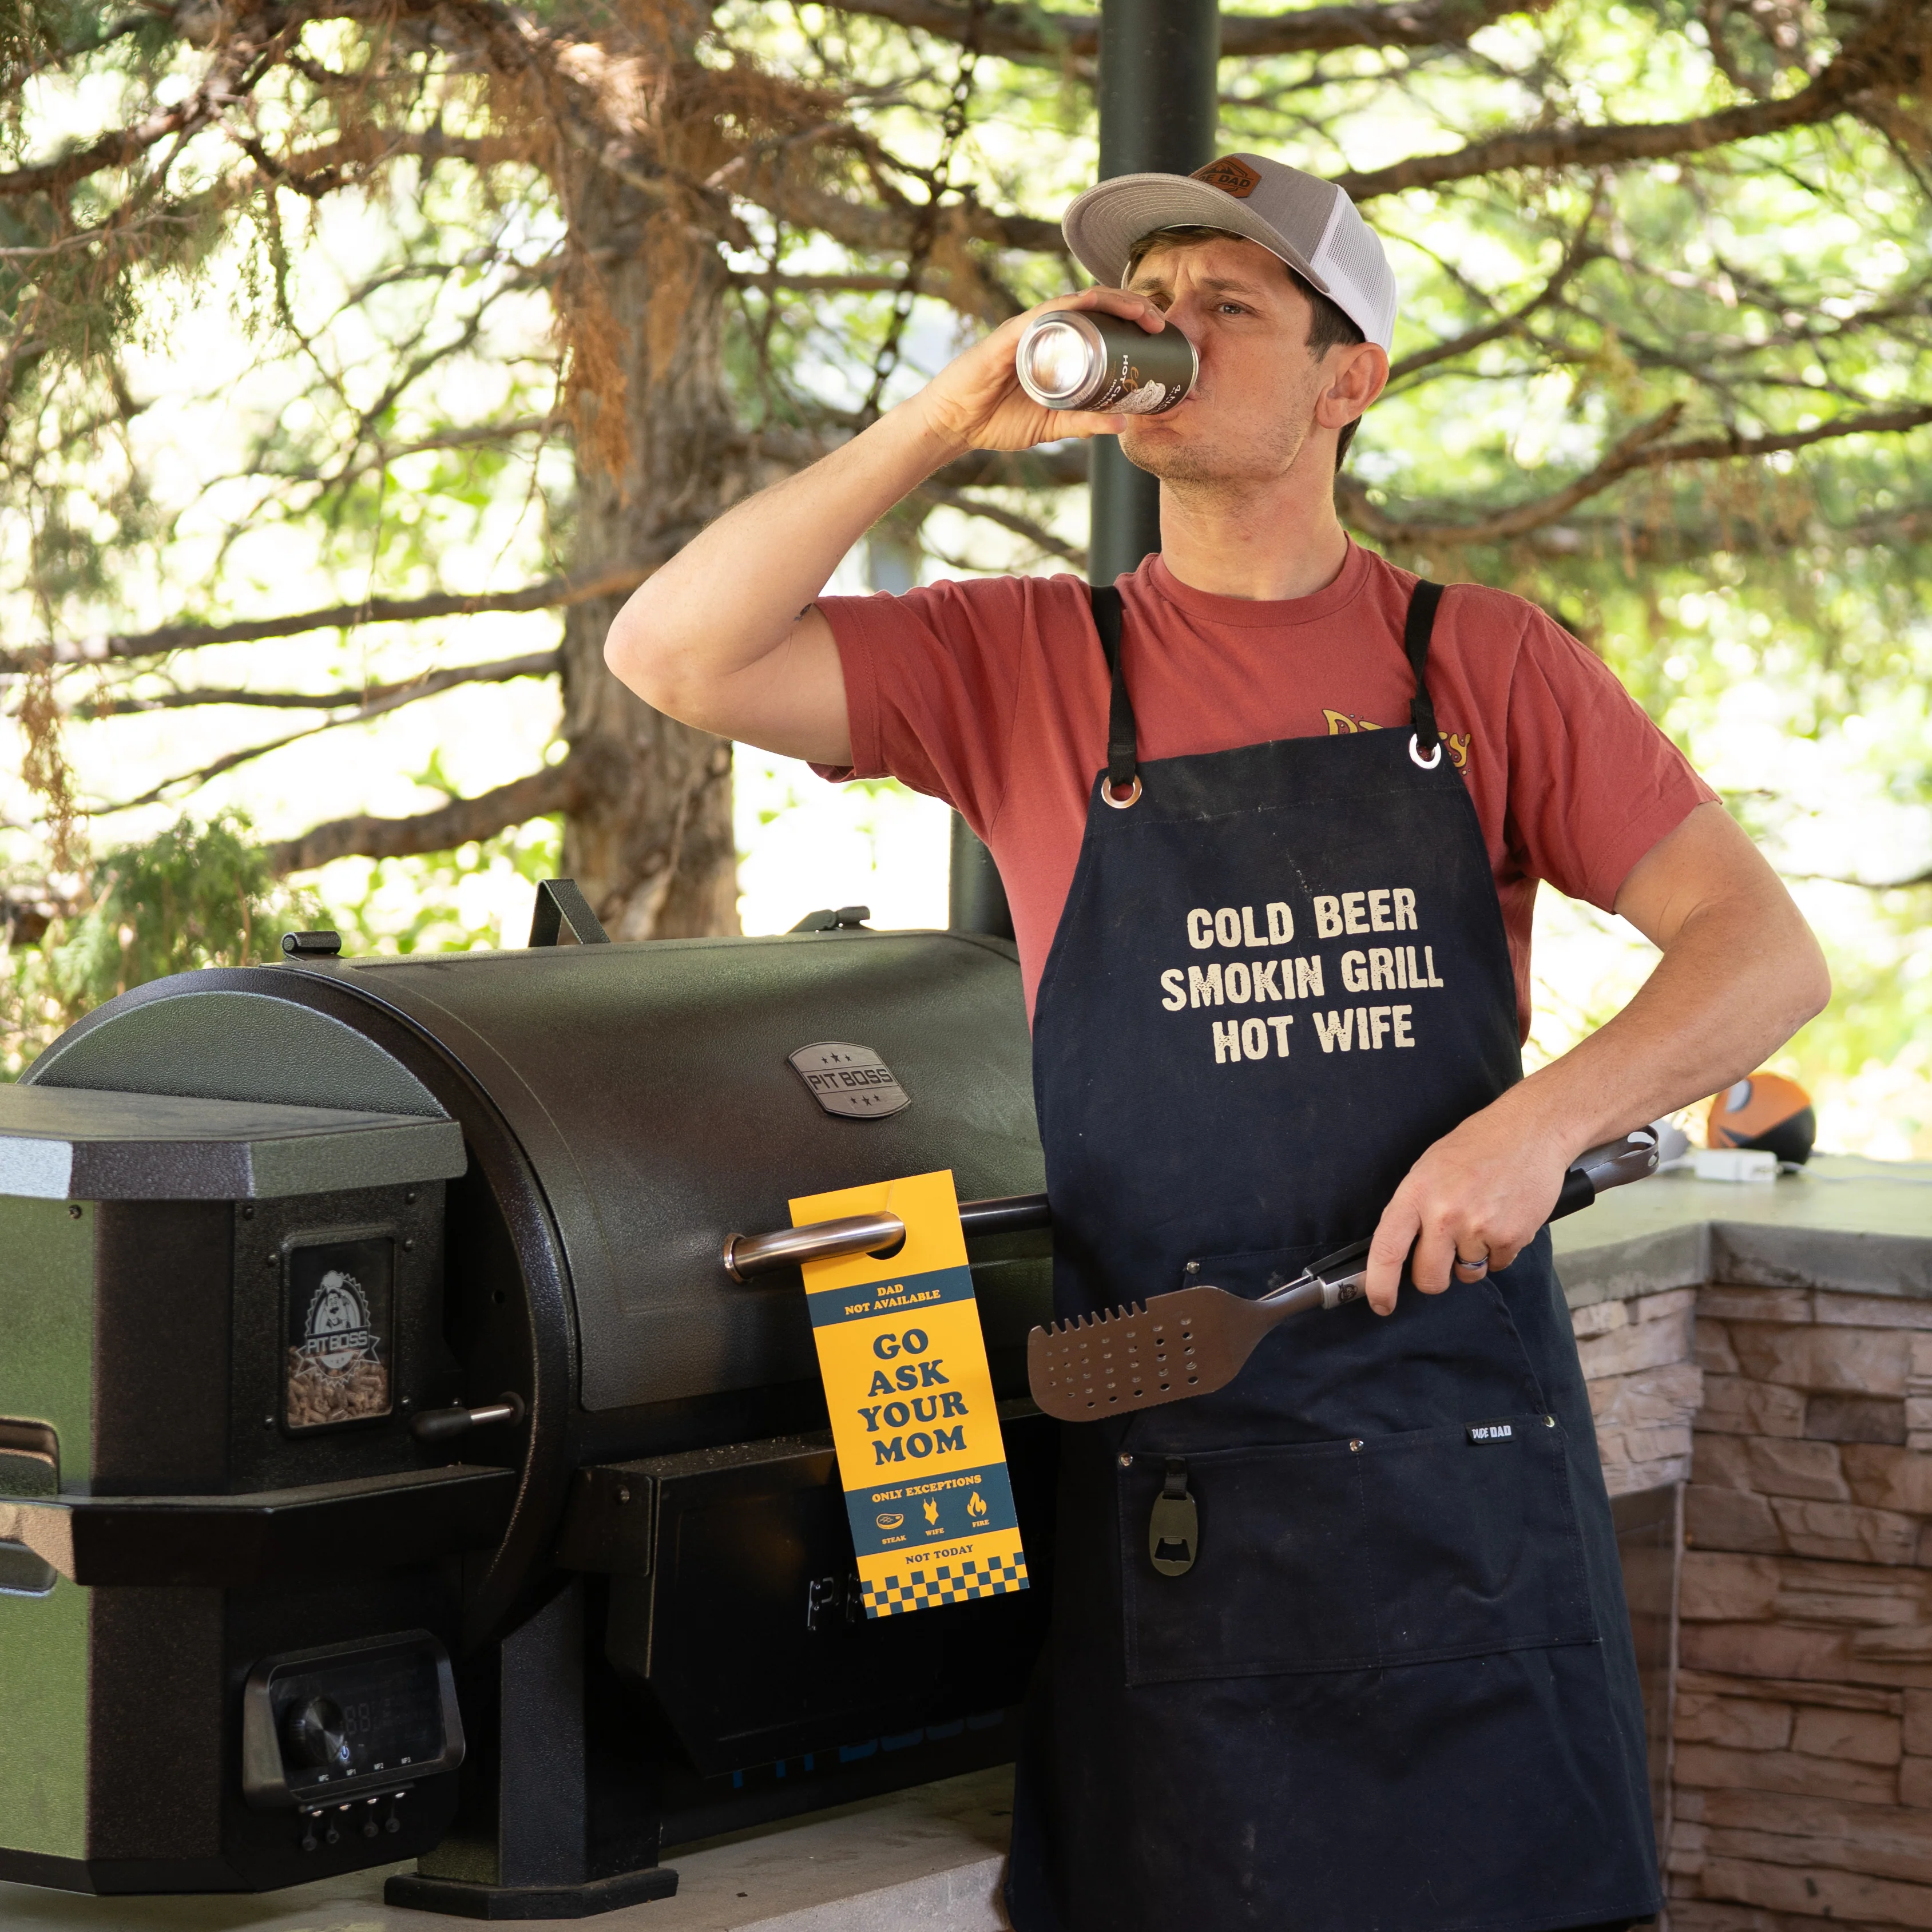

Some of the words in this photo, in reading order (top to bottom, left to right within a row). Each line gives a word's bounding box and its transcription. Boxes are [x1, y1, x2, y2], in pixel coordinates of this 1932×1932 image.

[1218, 174, 1251, 188] DAD
[1120, 354, 1129, 384] HOT
[1187, 901, 1295, 950] COLD
[1313, 887, 1418, 939] BEER
[1160, 954, 1326, 1012] SMOKIN
[1340, 945, 1444, 993] GRILL
[1212, 1014, 1294, 1064] HOT
[1312, 1004, 1416, 1054] WIFE
[807, 1073, 839, 1091] PIT
[838, 1068, 894, 1086] BOSS
[876, 1283, 904, 1297] DAD
[844, 1302, 871, 1316] NOT
[874, 1289, 941, 1311] AVAILABLE
[307, 1337, 328, 1354] PIT
[330, 1331, 367, 1350] BOSS
[872, 1328, 929, 1360] GO
[867, 1359, 950, 1397] ASK
[857, 1391, 969, 1433] YOUR
[1471, 1427, 1489, 1439] DUDE
[1489, 1425, 1512, 1438] DAD
[871, 1425, 967, 1466] MOM
[871, 1489, 903, 1503] ONLY
[906, 1474, 982, 1497] EXCEPTIONS
[925, 1528, 945, 1536] WIFE
[972, 1519, 990, 1528] FIRE
[882, 1534, 907, 1545] STEAK
[905, 1552, 931, 1565] NOT
[933, 1544, 974, 1559] TODAY
[346, 1768, 356, 1776] MP1
[374, 1762, 384, 1771] MP2
[401, 1756, 411, 1765] MP3
